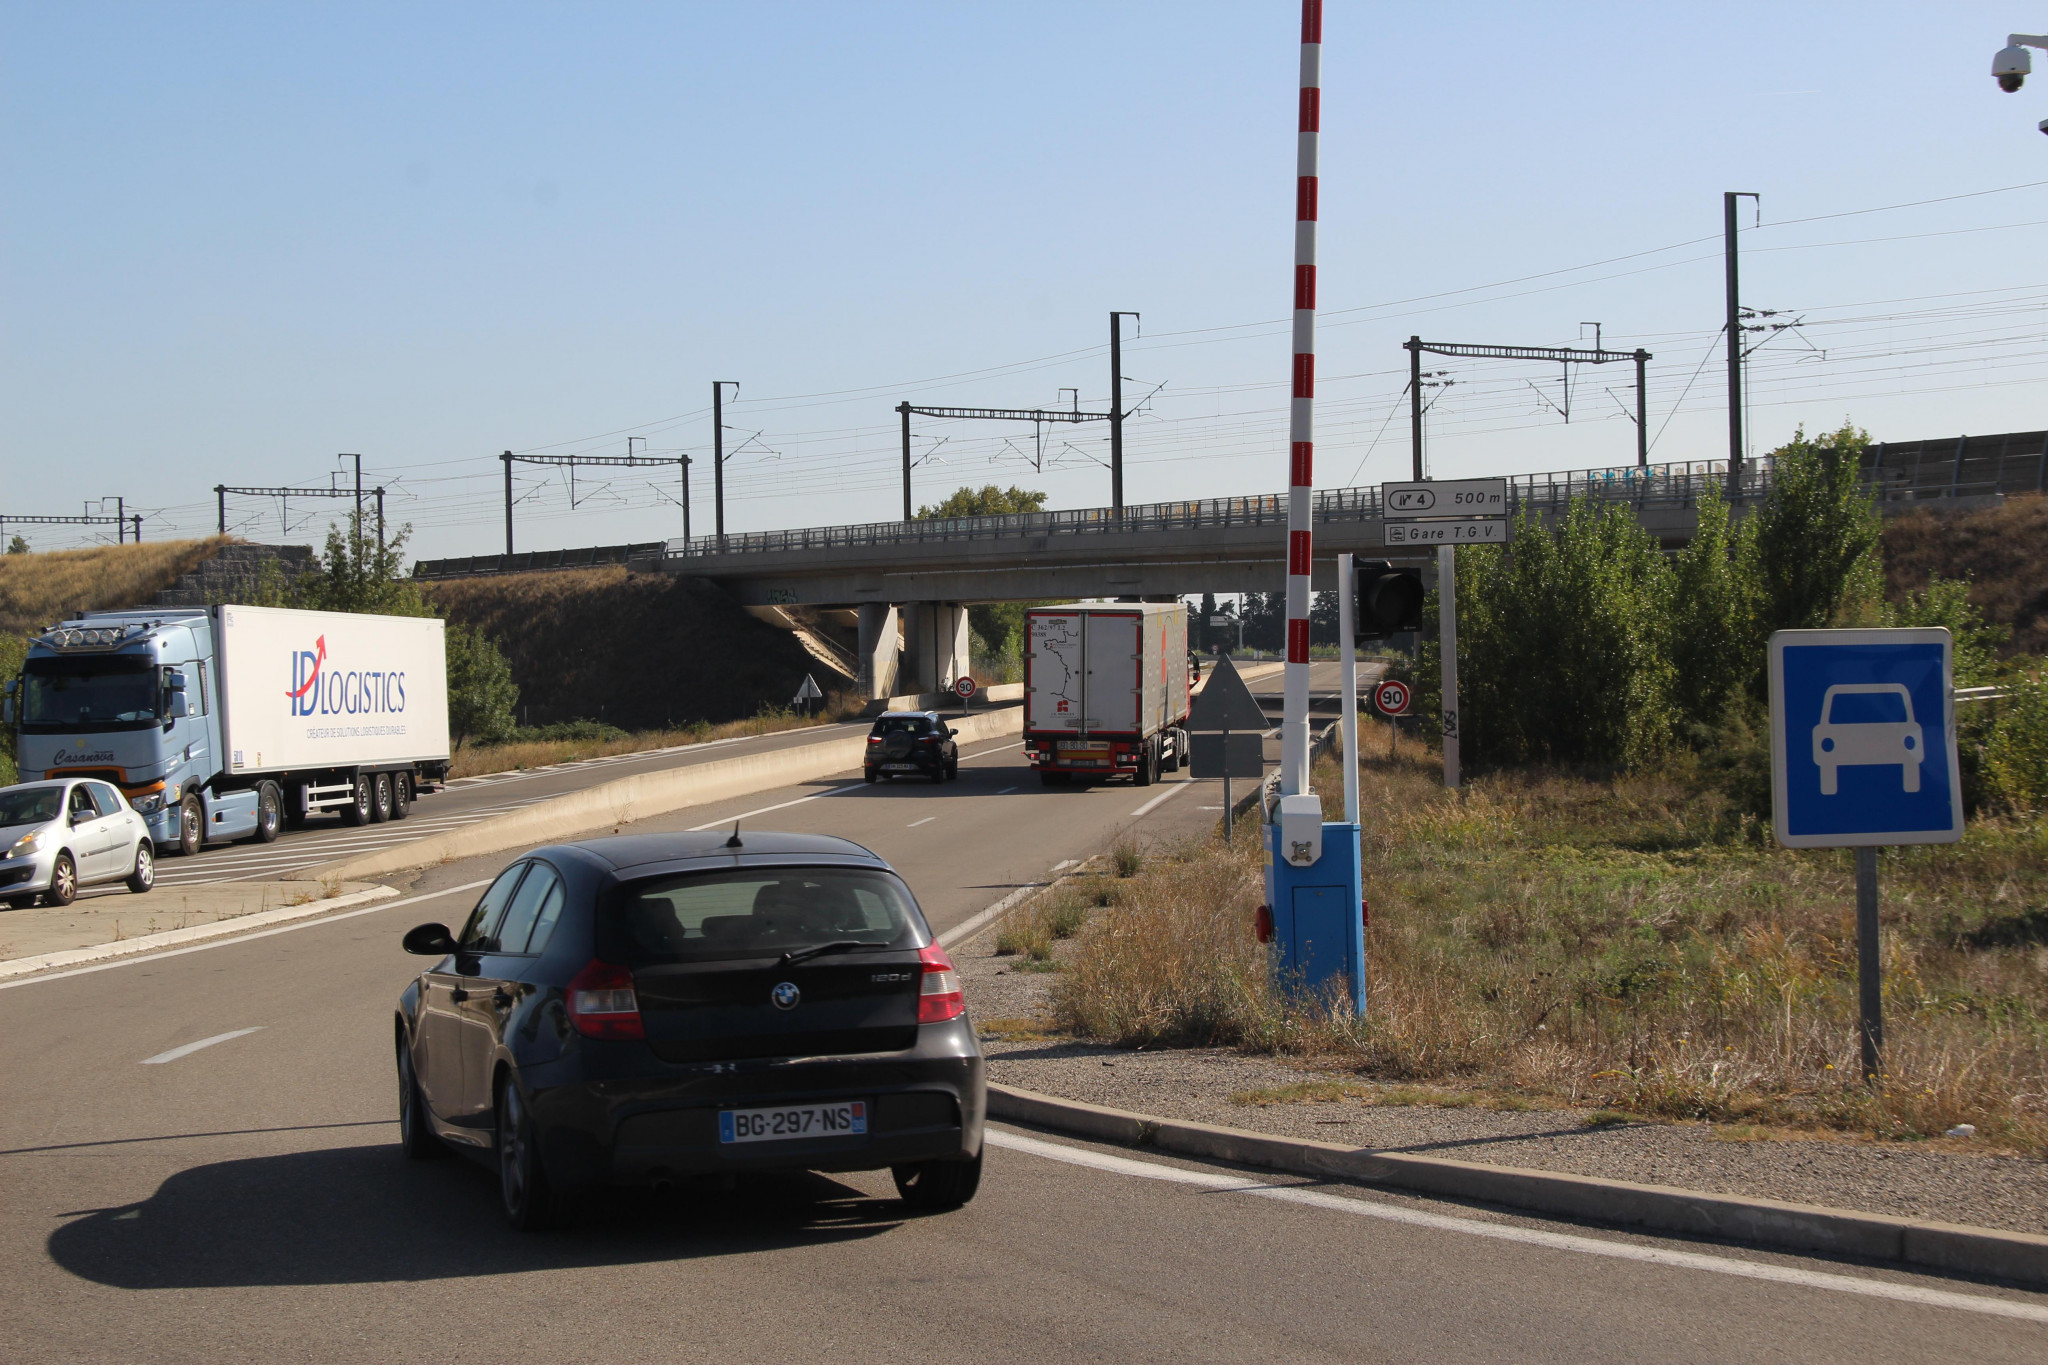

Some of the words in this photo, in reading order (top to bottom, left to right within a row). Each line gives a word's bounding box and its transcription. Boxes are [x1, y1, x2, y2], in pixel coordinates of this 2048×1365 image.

[1416, 494, 1426, 505] 4
[1454, 492, 1485, 504] 500
[1489, 494, 1500, 503] m
[1410, 528, 1444, 539] Gare
[291, 650, 320, 717] ID
[321, 671, 405, 714] LOGISTICS
[960, 683, 972, 692] 90
[1382, 690, 1402, 705] 90
[53, 749, 115, 766] Casanova
[872, 972, 912, 982] 120d
[736, 1107, 850, 1138] BG-297-NS
